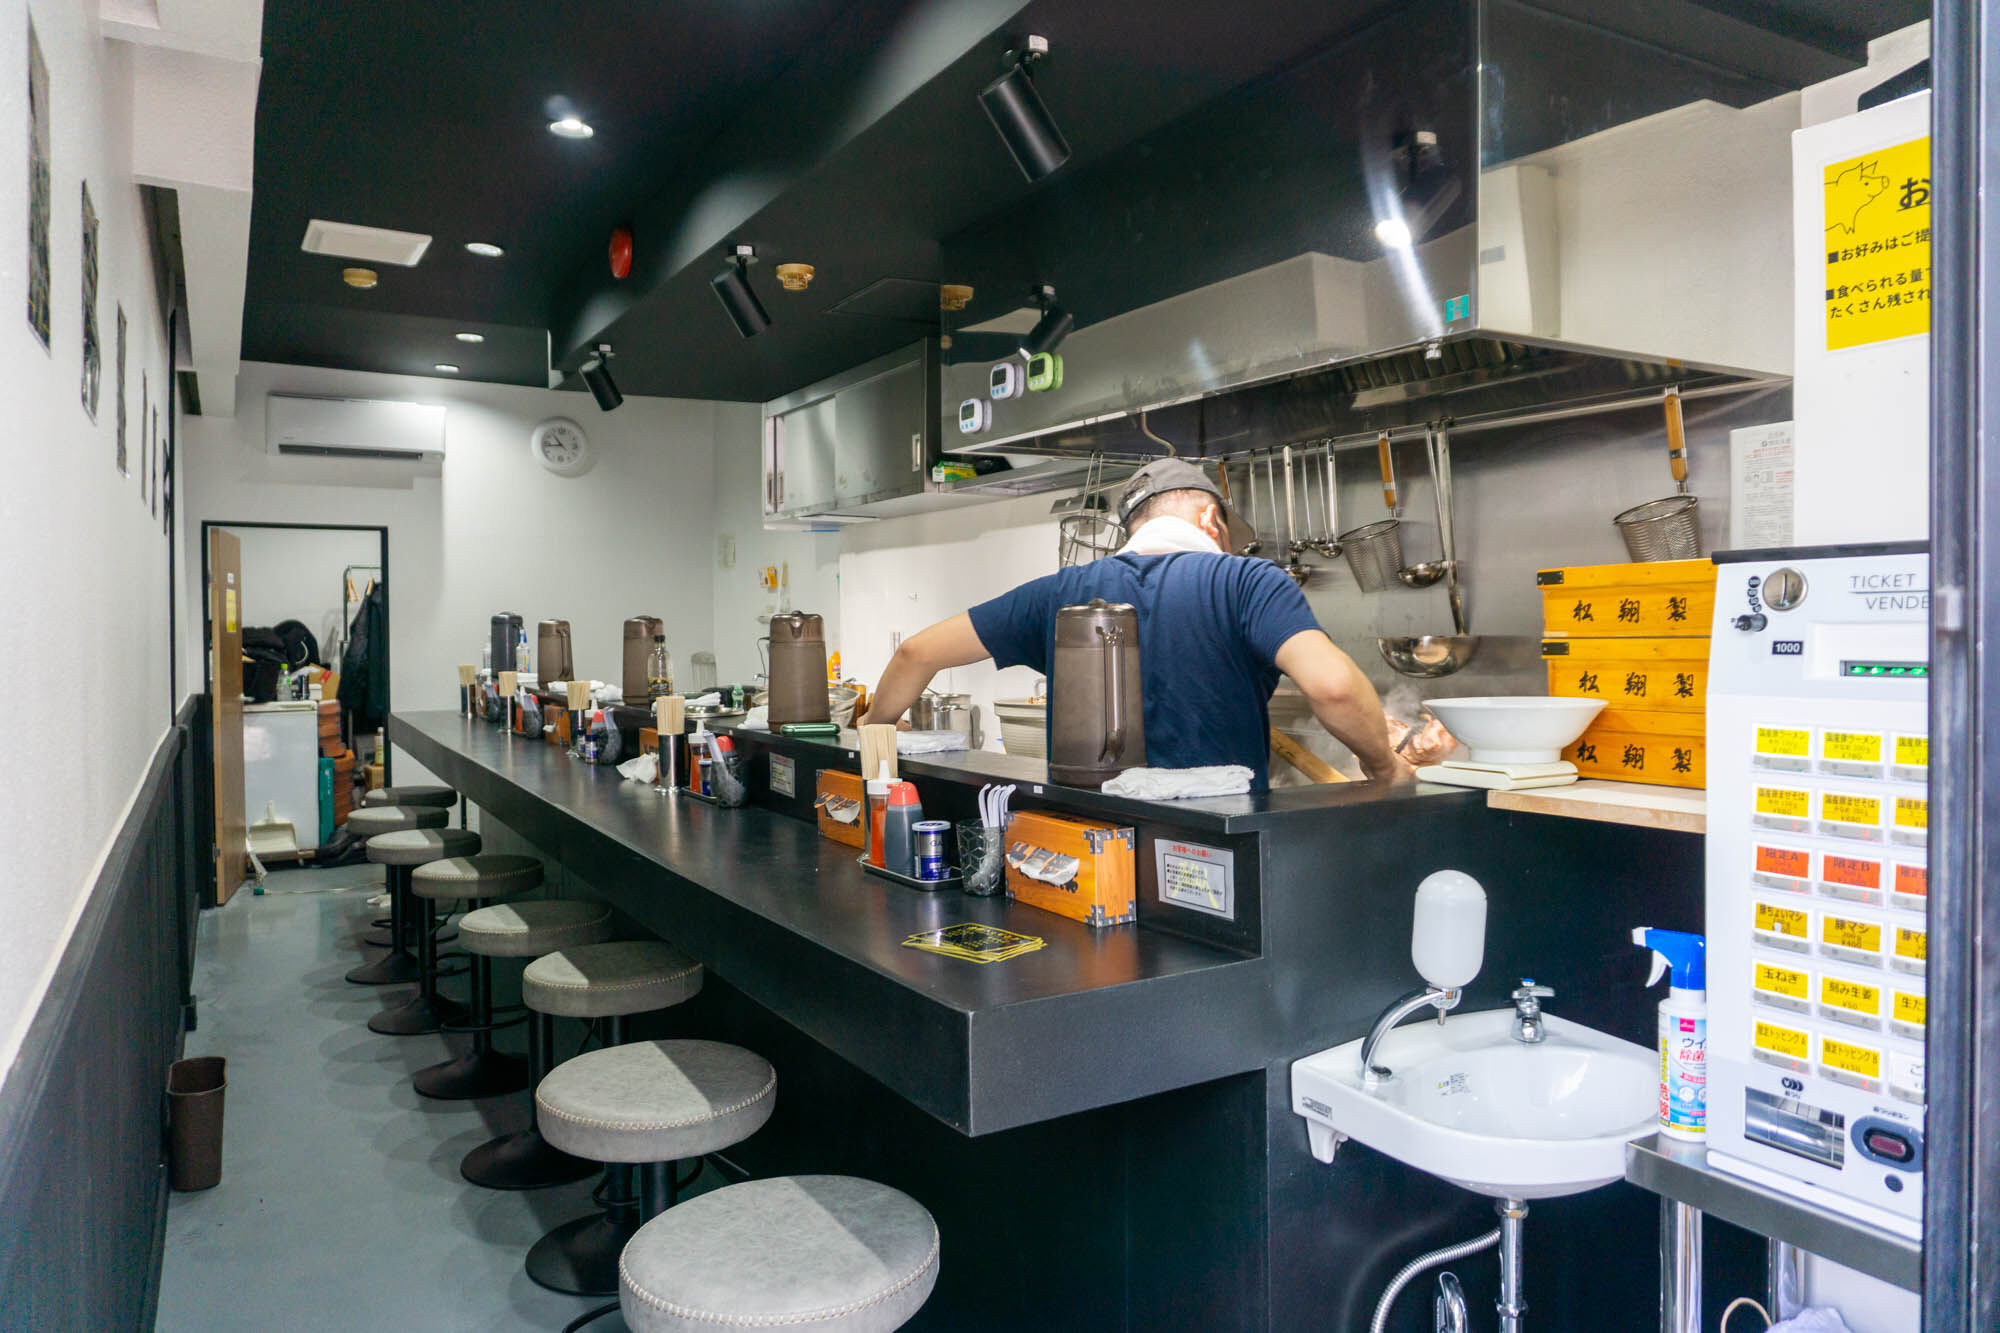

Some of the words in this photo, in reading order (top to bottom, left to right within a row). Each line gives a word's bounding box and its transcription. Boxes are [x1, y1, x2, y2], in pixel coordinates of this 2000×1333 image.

[1850, 573, 1917, 589] TICKET
[1776, 642, 1800, 653] 1000
[1763, 967, 1799, 984] 玉ねぎ
